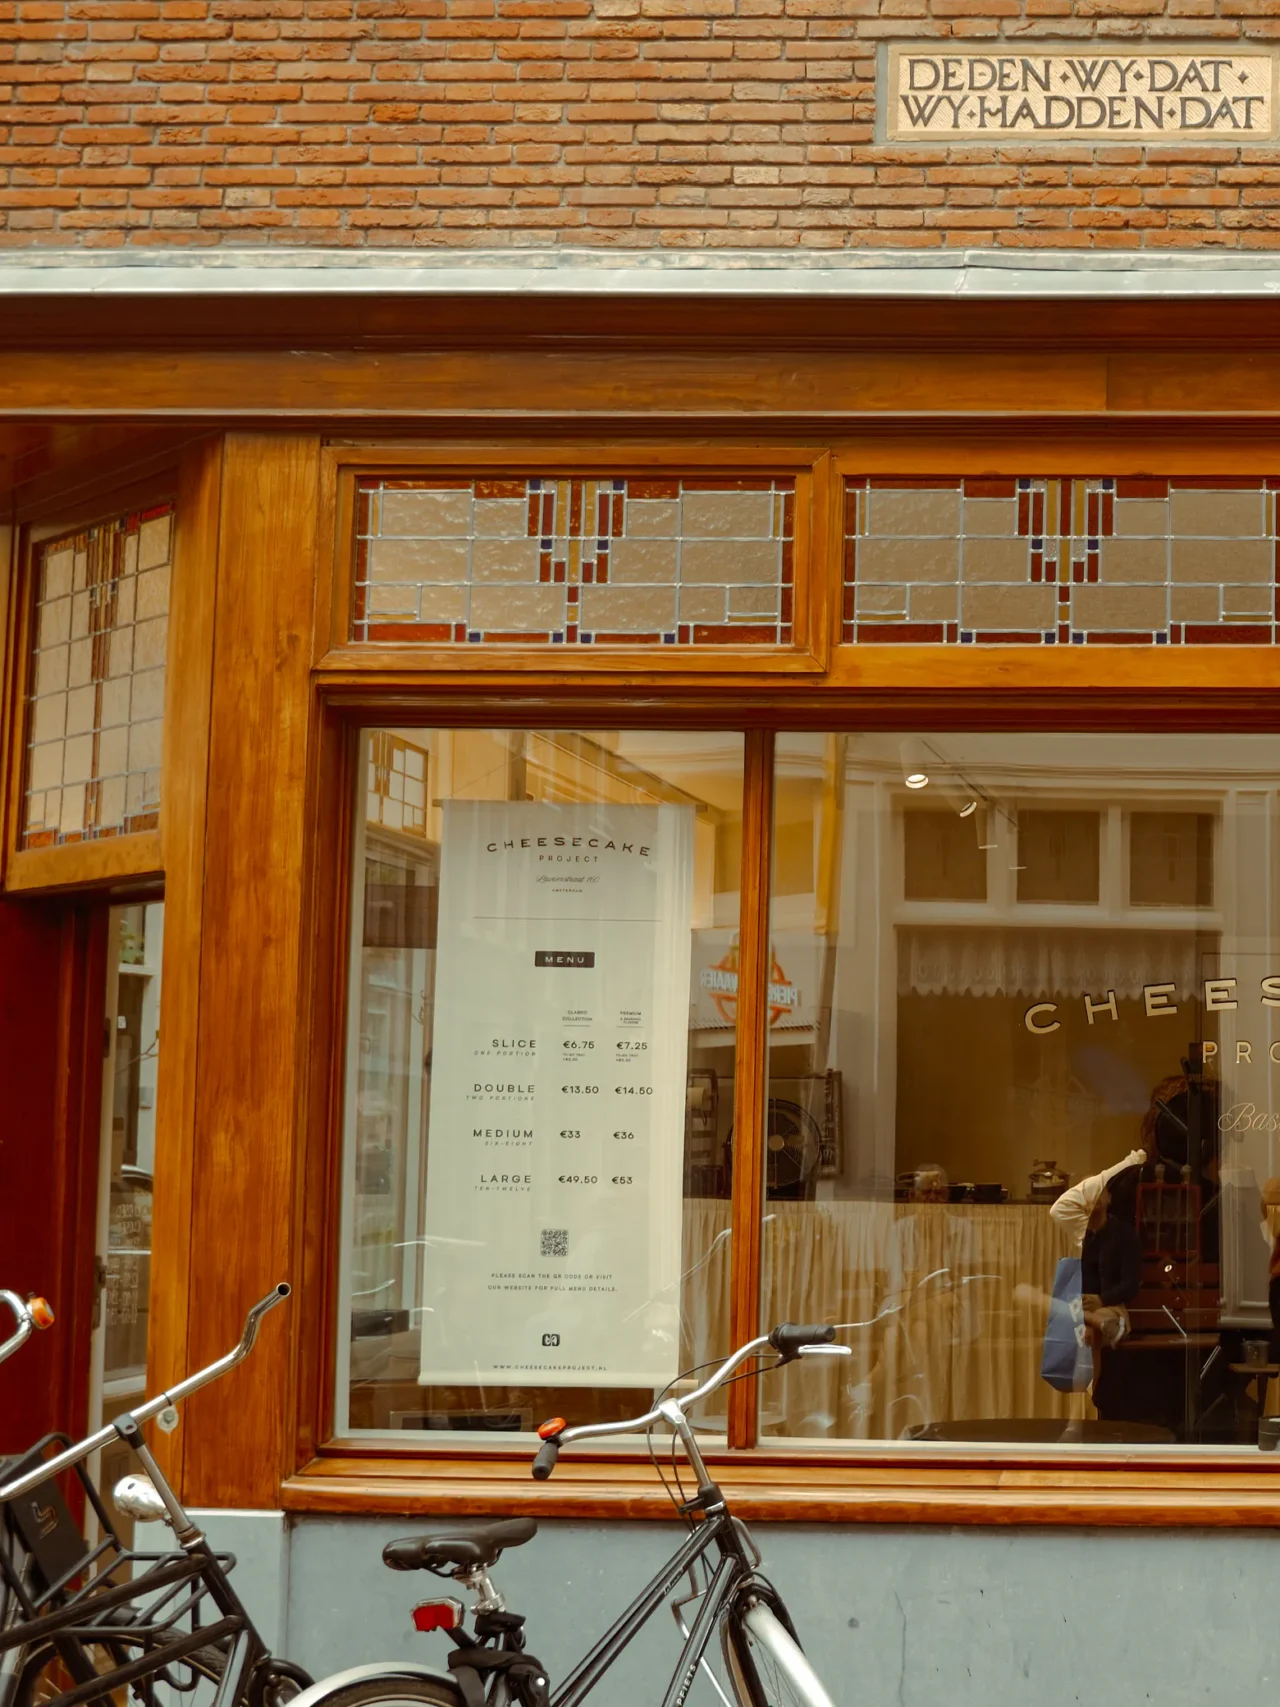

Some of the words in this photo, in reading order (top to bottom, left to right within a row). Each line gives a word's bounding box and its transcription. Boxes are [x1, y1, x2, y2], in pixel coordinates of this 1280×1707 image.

[486, 837, 650, 857] CHEESECAKE
[539, 854, 598, 863] PROJECT
[544, 955, 586, 965] MENU
[492, 1039, 536, 1049] SLICE
[562, 1040, 595, 1050] €6.75
[616, 1041, 648, 1051] €7.25
[473, 1083, 535, 1093] DOUBLE
[561, 1085, 600, 1095] €13.50
[614, 1086, 653, 1095] €14.50
[472, 1128, 533, 1139] MEDIUM
[559, 1130, 581, 1139] €33
[613, 1131, 635, 1140] €36
[480, 1174, 531, 1184] LARGE
[558, 1175, 598, 1184] €49.50
[611, 1176, 633, 1185] €53
